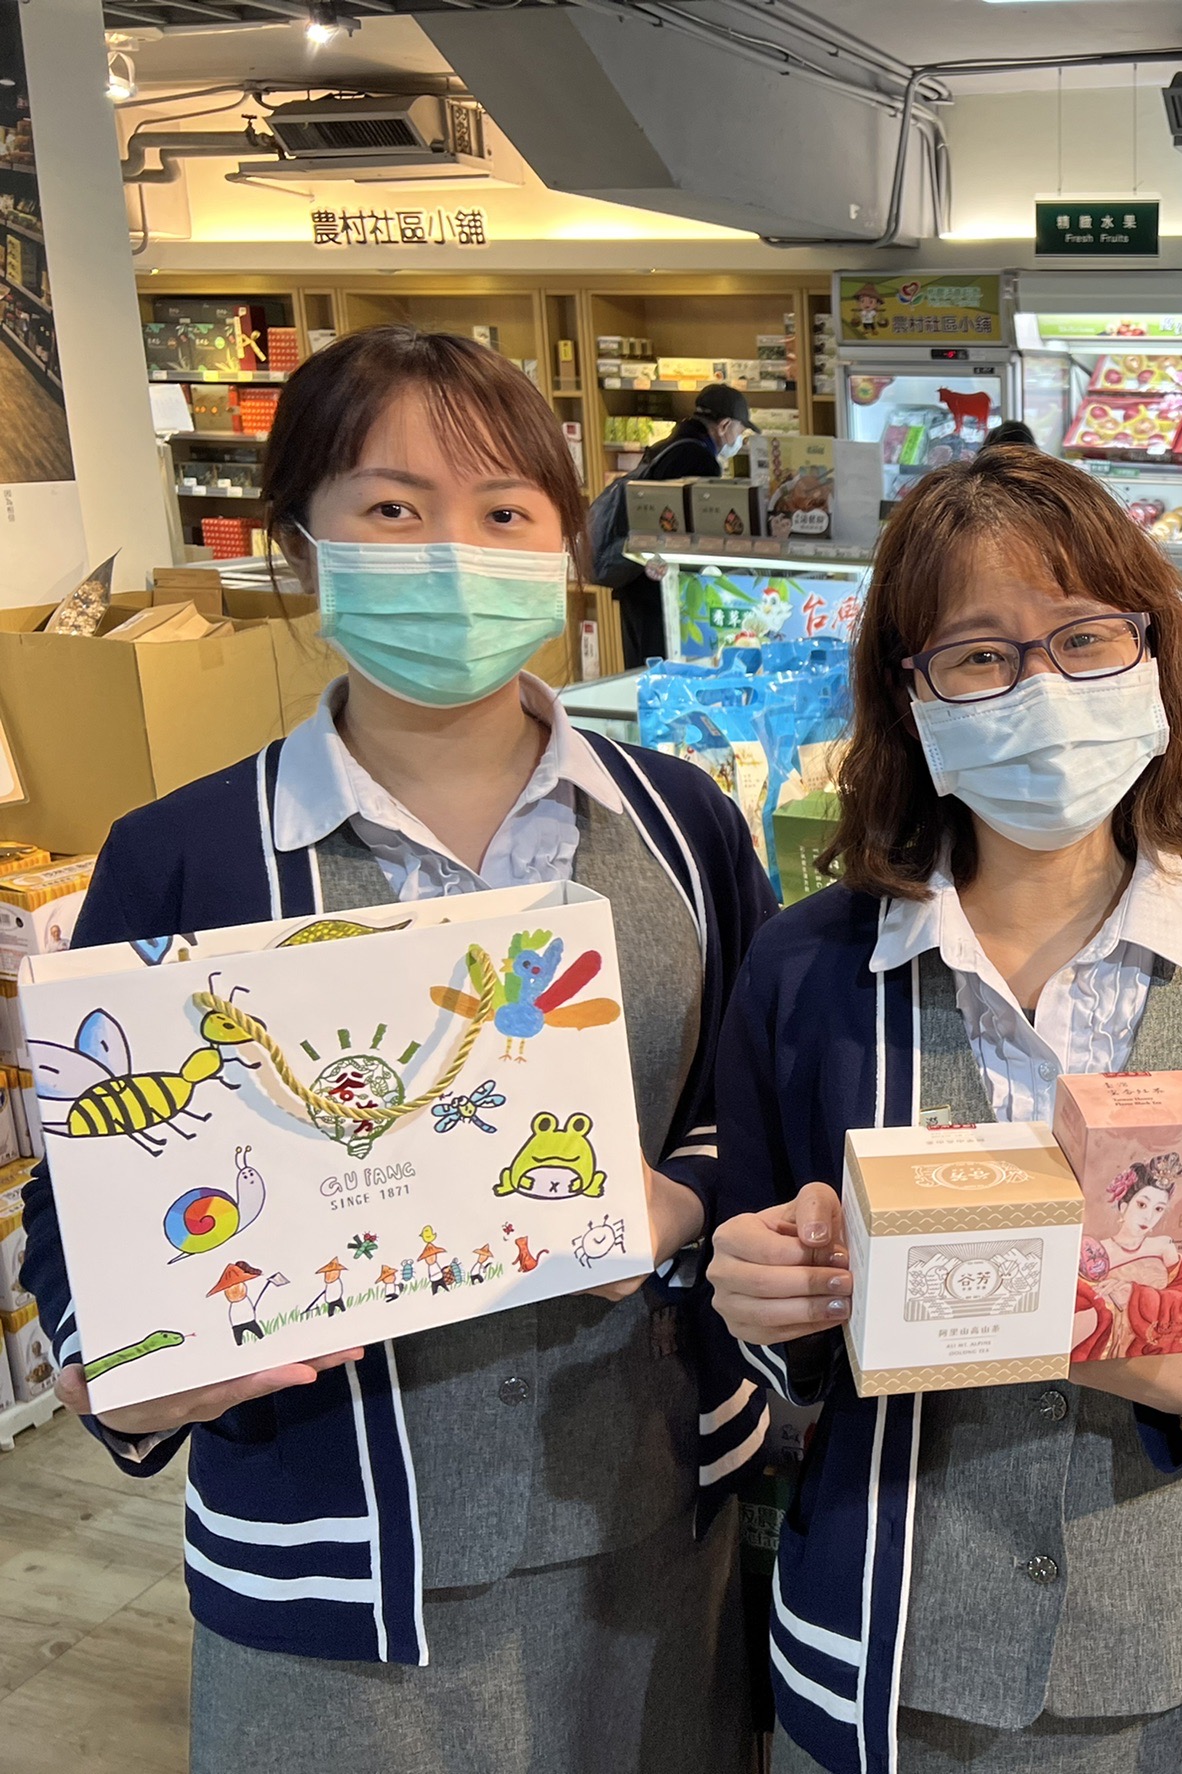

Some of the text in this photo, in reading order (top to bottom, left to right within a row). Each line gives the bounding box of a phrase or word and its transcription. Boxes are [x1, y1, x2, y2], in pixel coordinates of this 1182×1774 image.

[311, 209, 487, 246] 農村社區小舖
[1064, 233, 1130, 243] Fresh Fruits
[320, 1161, 417, 1197] GU FANG
[330, 1184, 411, 1212] SINCE 1871
[957, 1270, 992, 1287] 谷芳
